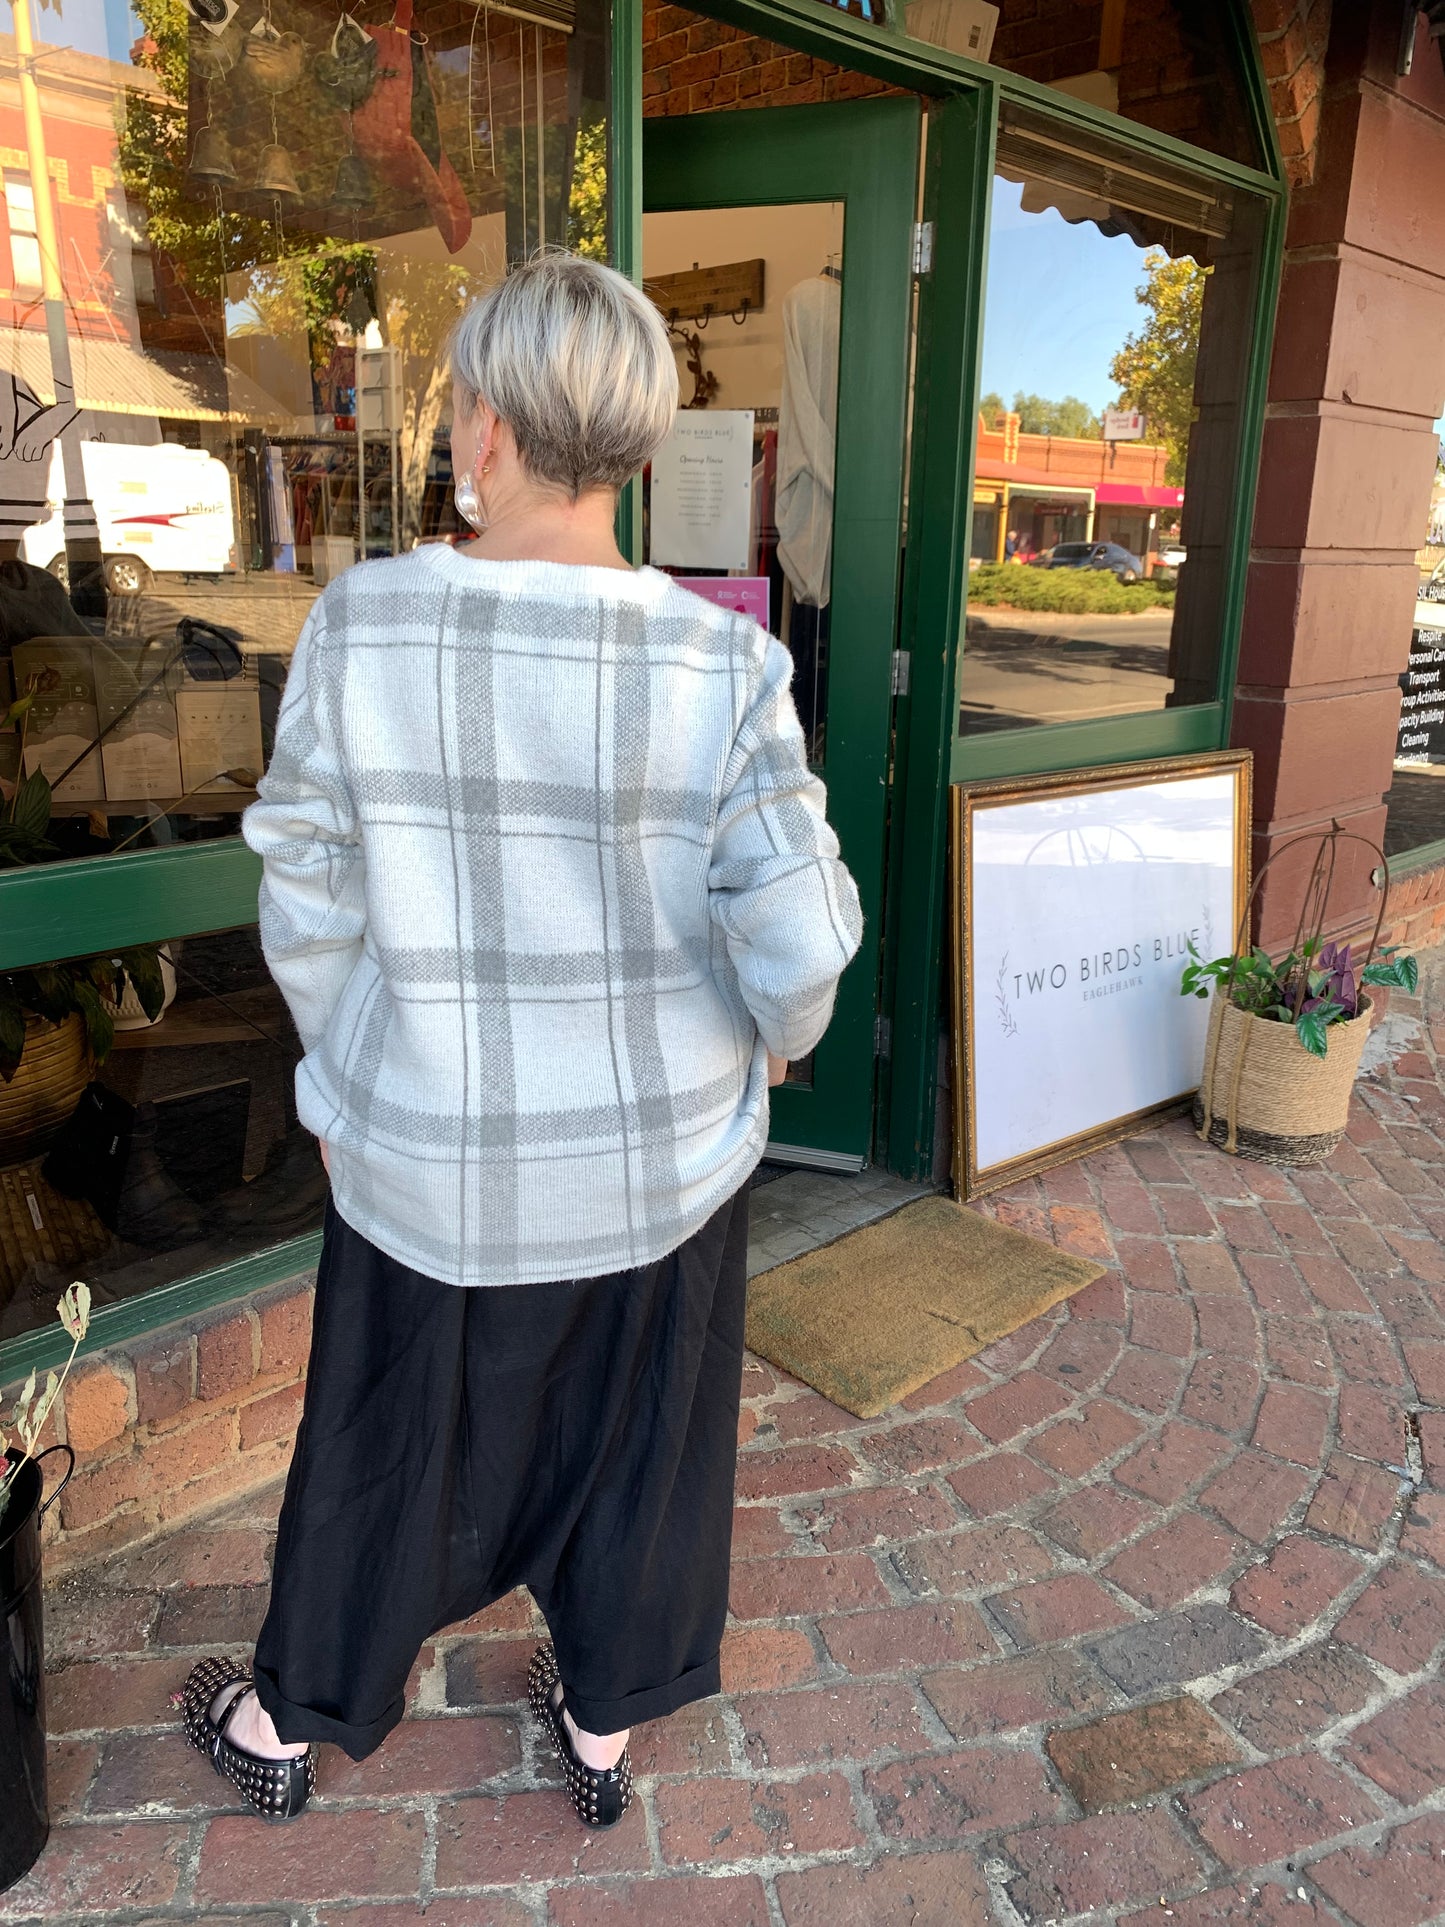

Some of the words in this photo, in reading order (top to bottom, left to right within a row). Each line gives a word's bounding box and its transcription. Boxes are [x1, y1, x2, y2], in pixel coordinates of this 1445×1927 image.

[1418, 629, 1442, 645] Respite
[1409, 649, 1434, 666] ersonal
[1409, 670, 1440, 686] Transport
[1400, 693, 1417, 709] roup
[1416, 689, 1445, 705] Activities
[1399, 713, 1420, 731] pacity
[1420, 708, 1445, 725] Building
[1402, 732, 1429, 747] Cleaning
[1013, 963, 1067, 999] TWO
[1080, 944, 1142, 981] BIRDS
[1154, 928, 1200, 962] BLUE
[1083, 975, 1144, 1001] EAGLEHAWK
